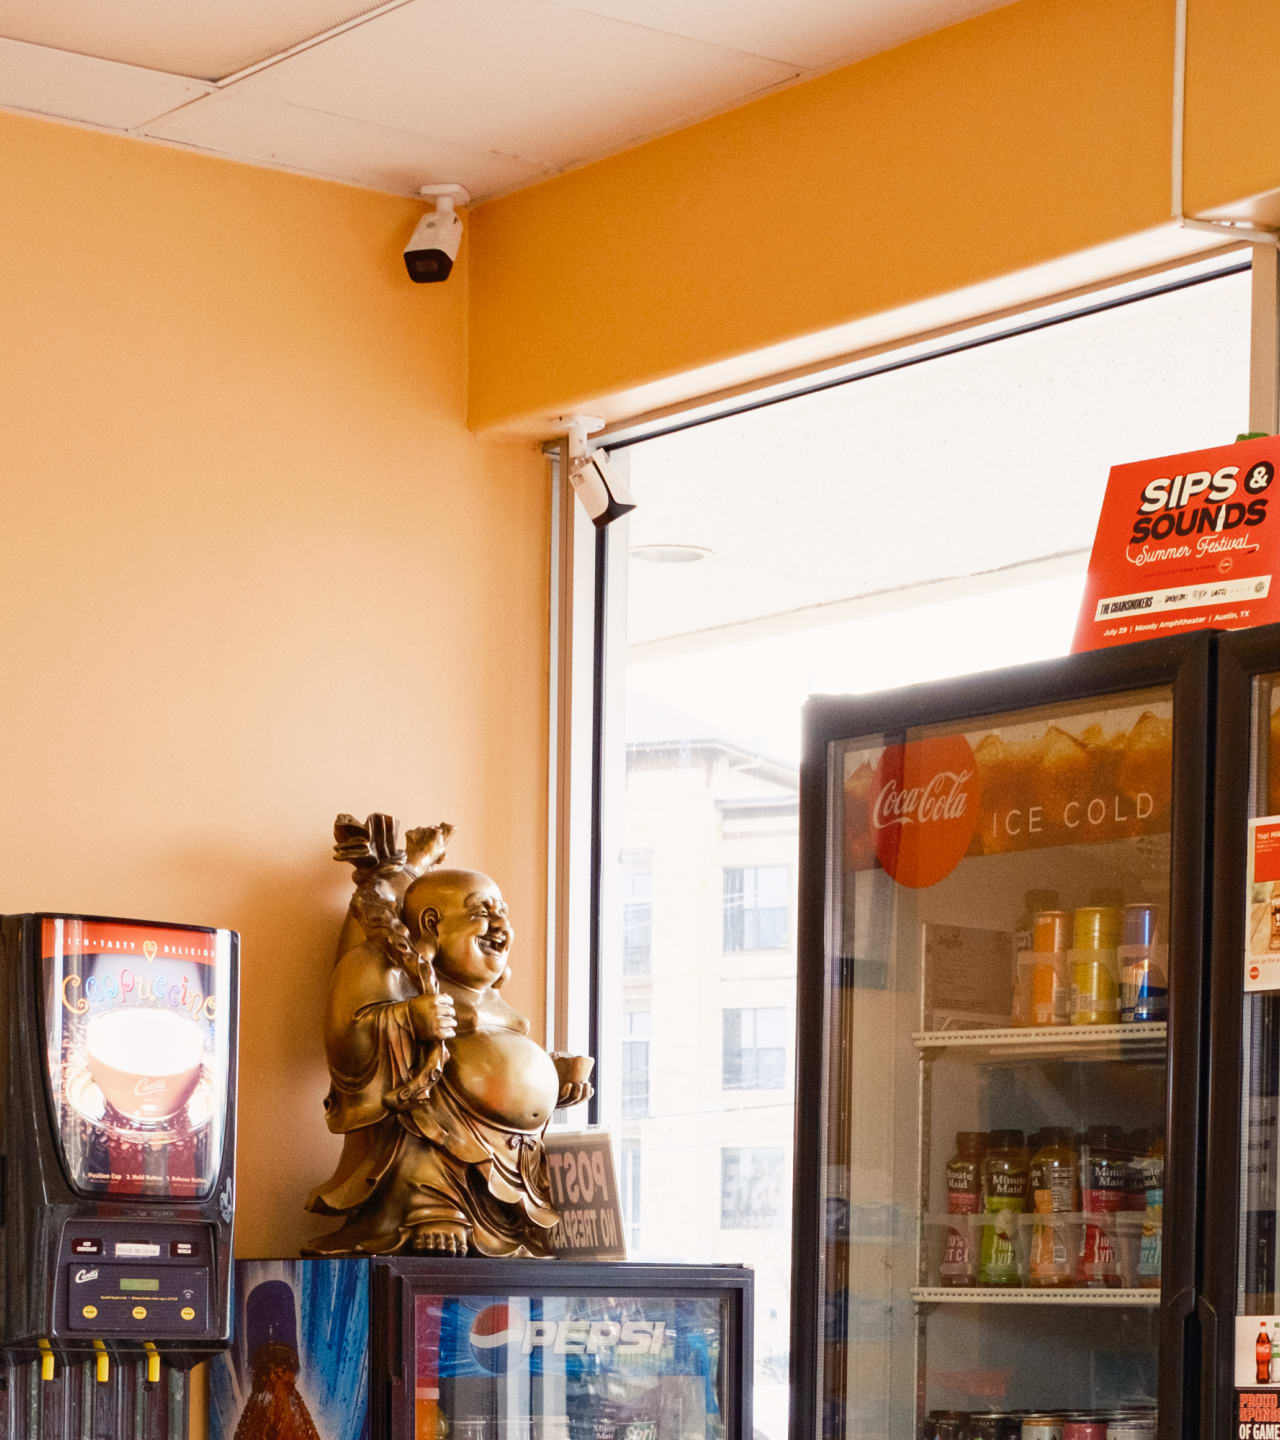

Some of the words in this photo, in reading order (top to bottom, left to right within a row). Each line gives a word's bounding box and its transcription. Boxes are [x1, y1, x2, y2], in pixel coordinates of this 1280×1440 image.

[1138, 466, 1240, 515] SIPS
[1130, 499, 1268, 544] SOUNDS
[1126, 543, 1192, 566] Summer
[1196, 534, 1260, 558] Festival
[873, 769, 973, 829] Coca-Cola
[992, 806, 1043, 837] ICE
[1063, 793, 1154, 828] COLD
[100, 939, 135, 950] TASTY
[521, 1321, 666, 1354] PEPSI
[1240, 1394, 1278, 1408] PROUD
[1239, 1424, 1251, 1440] OF
